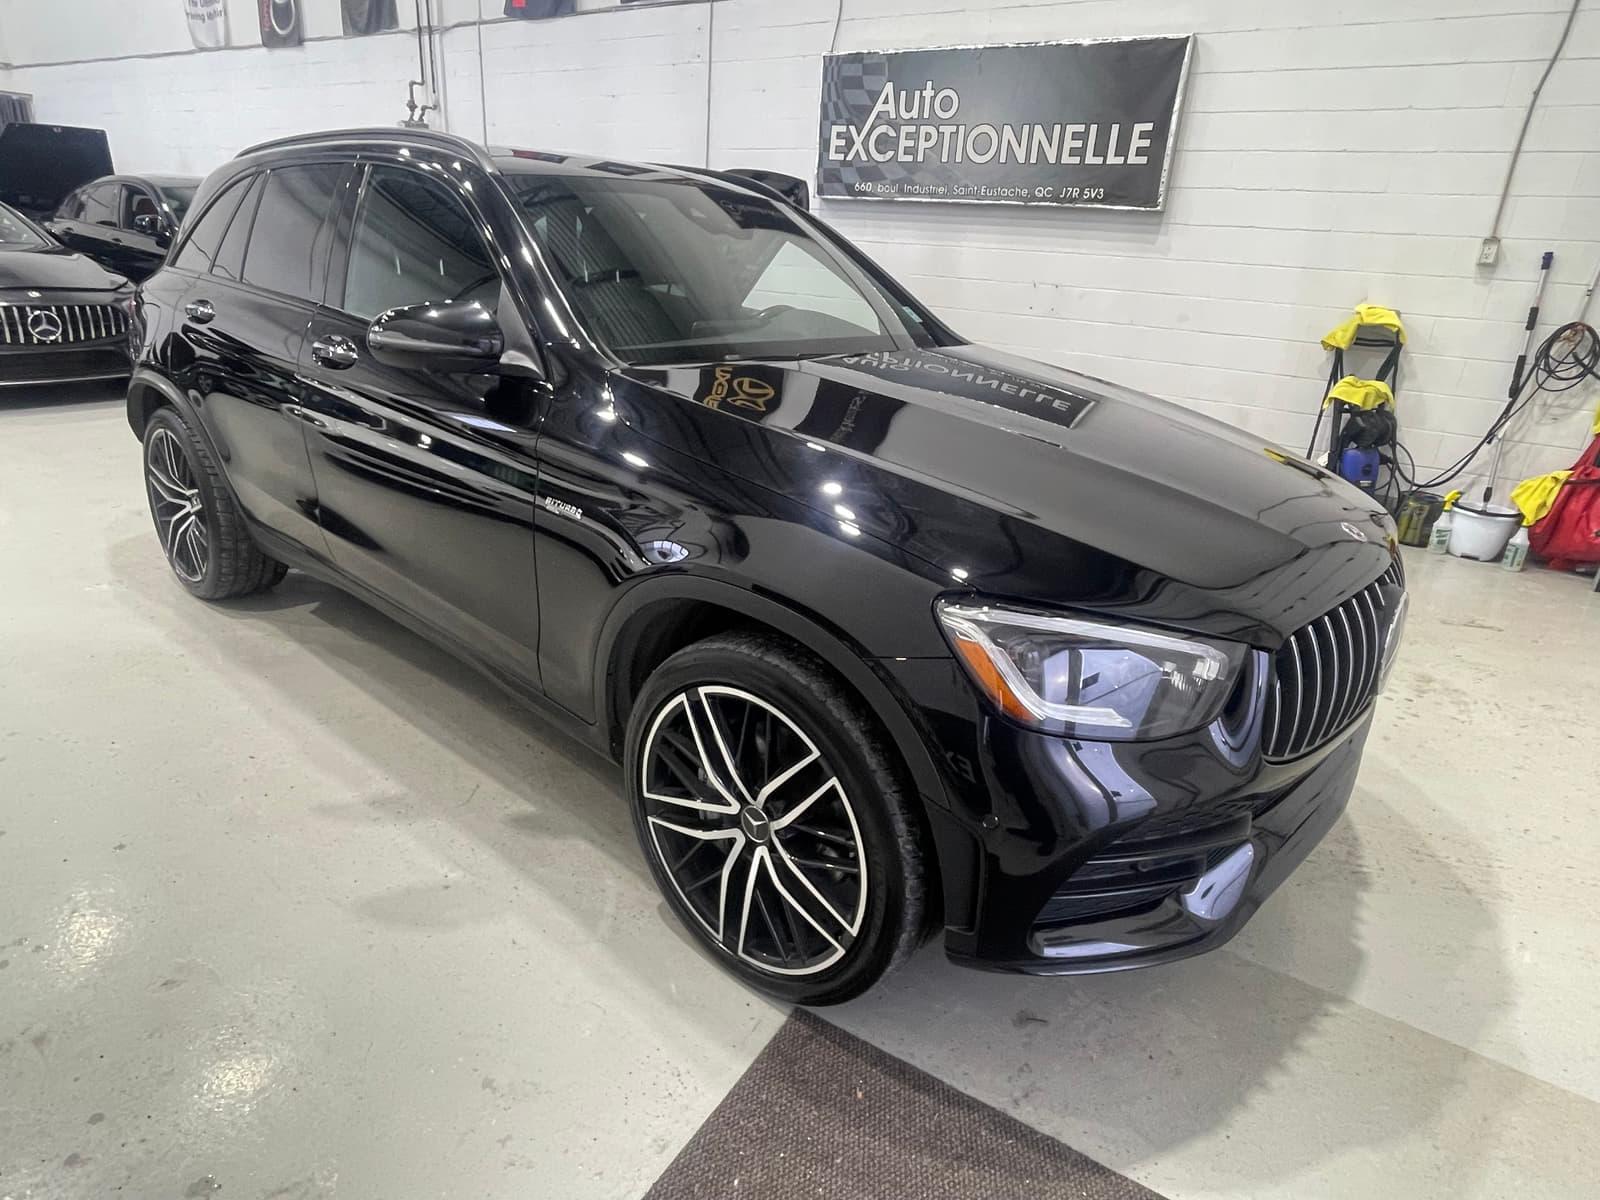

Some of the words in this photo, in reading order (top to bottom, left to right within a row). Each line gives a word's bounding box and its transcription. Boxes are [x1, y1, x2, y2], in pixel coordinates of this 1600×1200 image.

[868, 80, 960, 120] Auto
[829, 122, 1154, 165] EXCEPTIONNELLE
[1034, 186, 1054, 198] QC
[1059, 187, 1080, 198] J7R
[1083, 188, 1104, 199] 5V3
